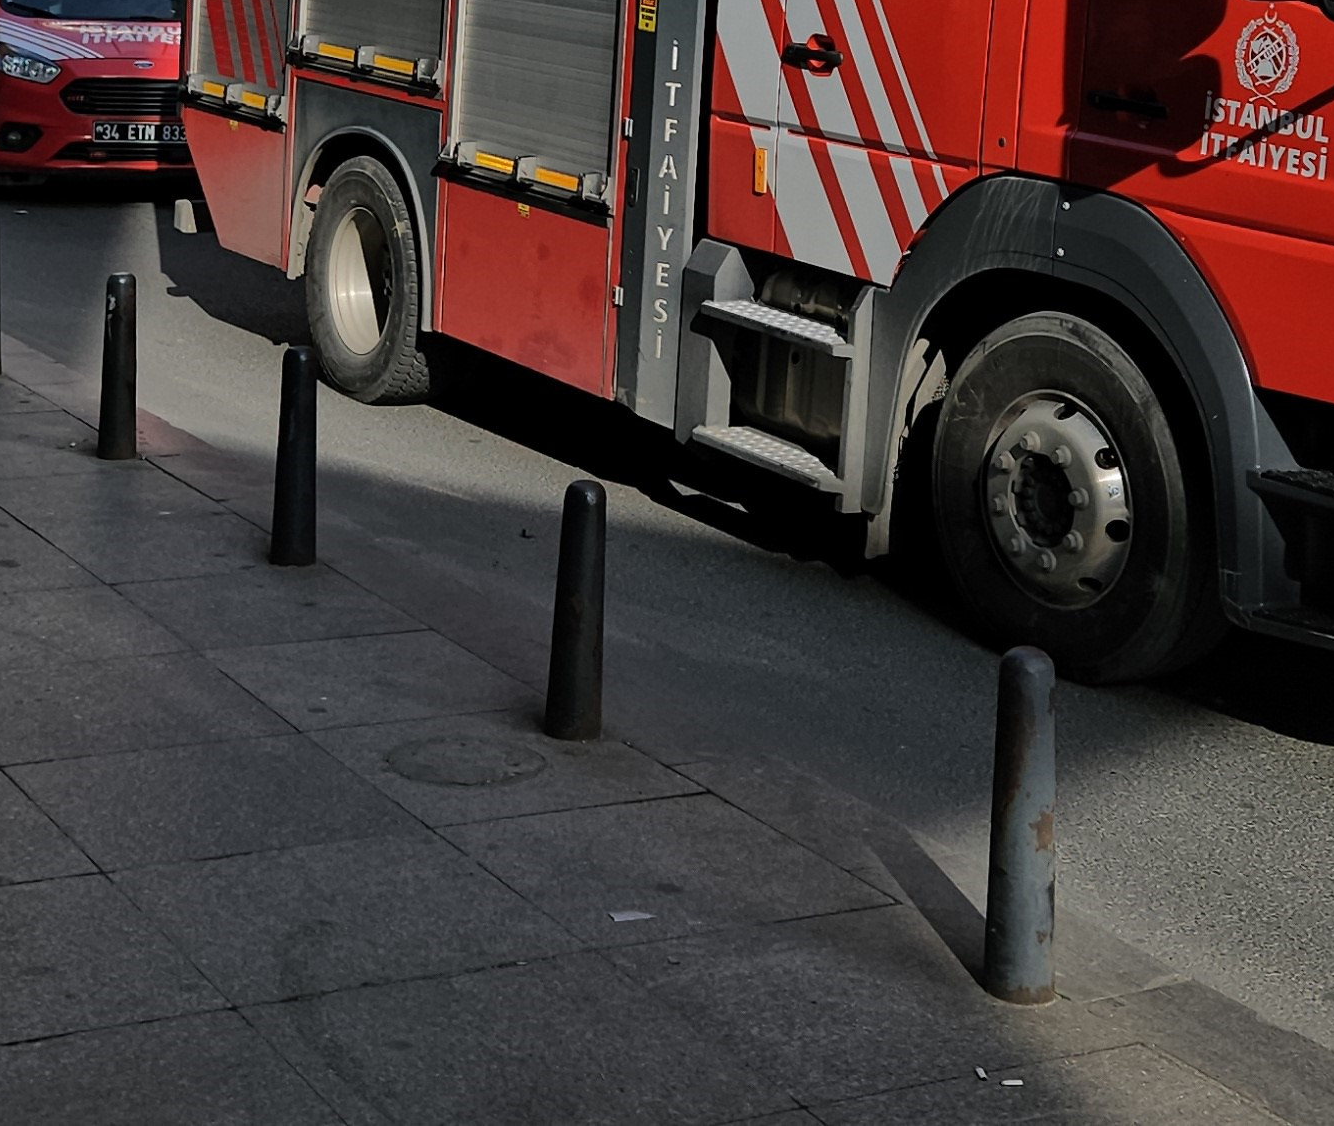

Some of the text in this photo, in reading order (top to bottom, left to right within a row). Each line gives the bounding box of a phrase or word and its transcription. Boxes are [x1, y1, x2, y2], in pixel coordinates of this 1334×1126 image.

[79, 24, 182, 34] İSTANBU
[101, 124, 186, 141] 34 ETM 833
[1204, 90, 1329, 144] İSTANBUL
[1200, 125, 1328, 180] İTFAİYESİ
[653, 39, 682, 359] İTFAİYESİ
